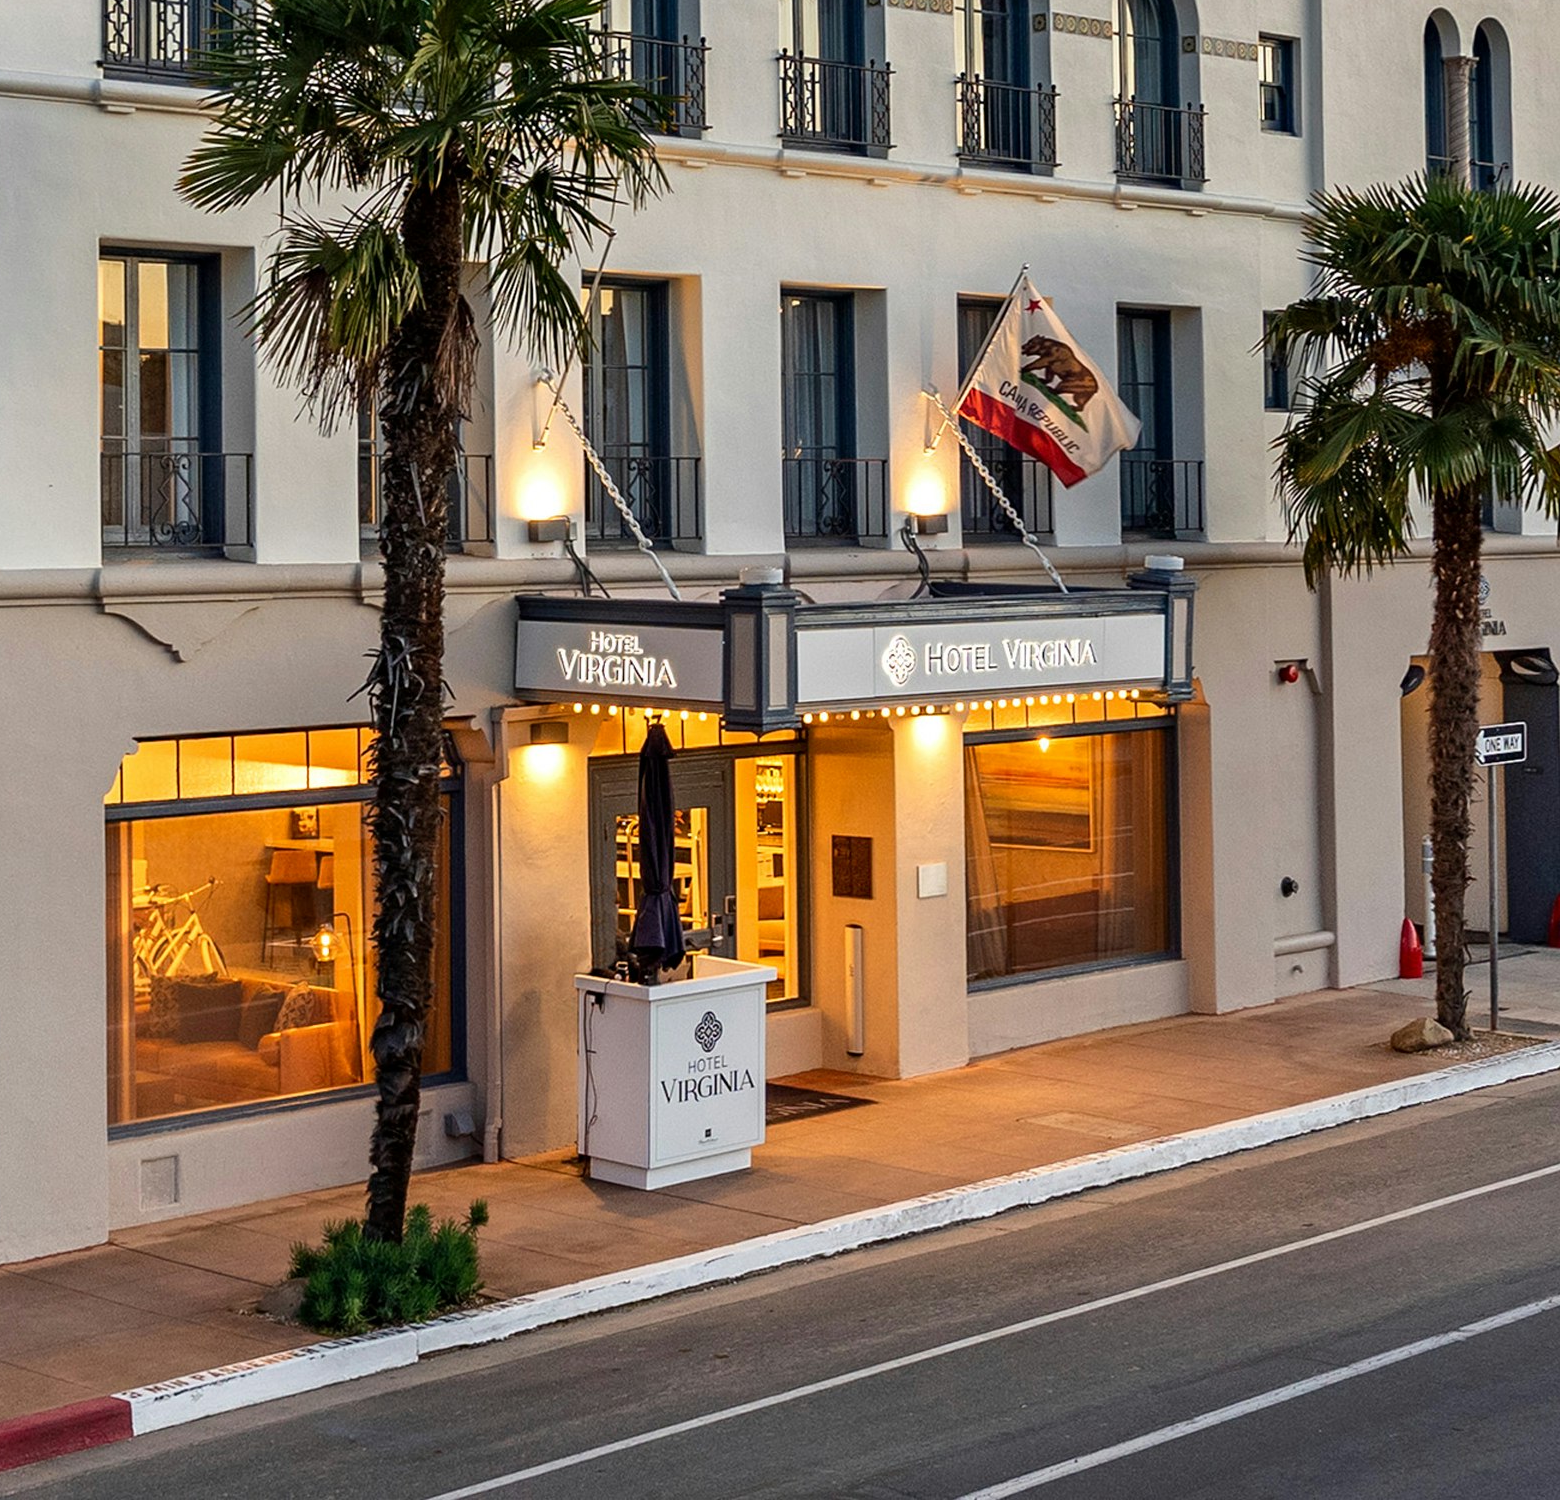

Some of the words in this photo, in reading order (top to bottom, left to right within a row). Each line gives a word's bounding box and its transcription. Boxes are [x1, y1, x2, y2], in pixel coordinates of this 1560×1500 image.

[1027, 402, 1080, 454] REPUBLIC
[591, 631, 644, 655] HOTEL
[924, 641, 998, 675] HOTEL
[1002, 638, 1098, 671] VIRGINIA
[556, 648, 678, 688] VIRGINIA
[1485, 737, 1501, 753] ONE
[1503, 735, 1520, 751] WAY
[688, 1055, 727, 1074] HOTEL
[660, 1069, 755, 1104] VIRGINIA
[144, 1379, 189, 1394] MIN
